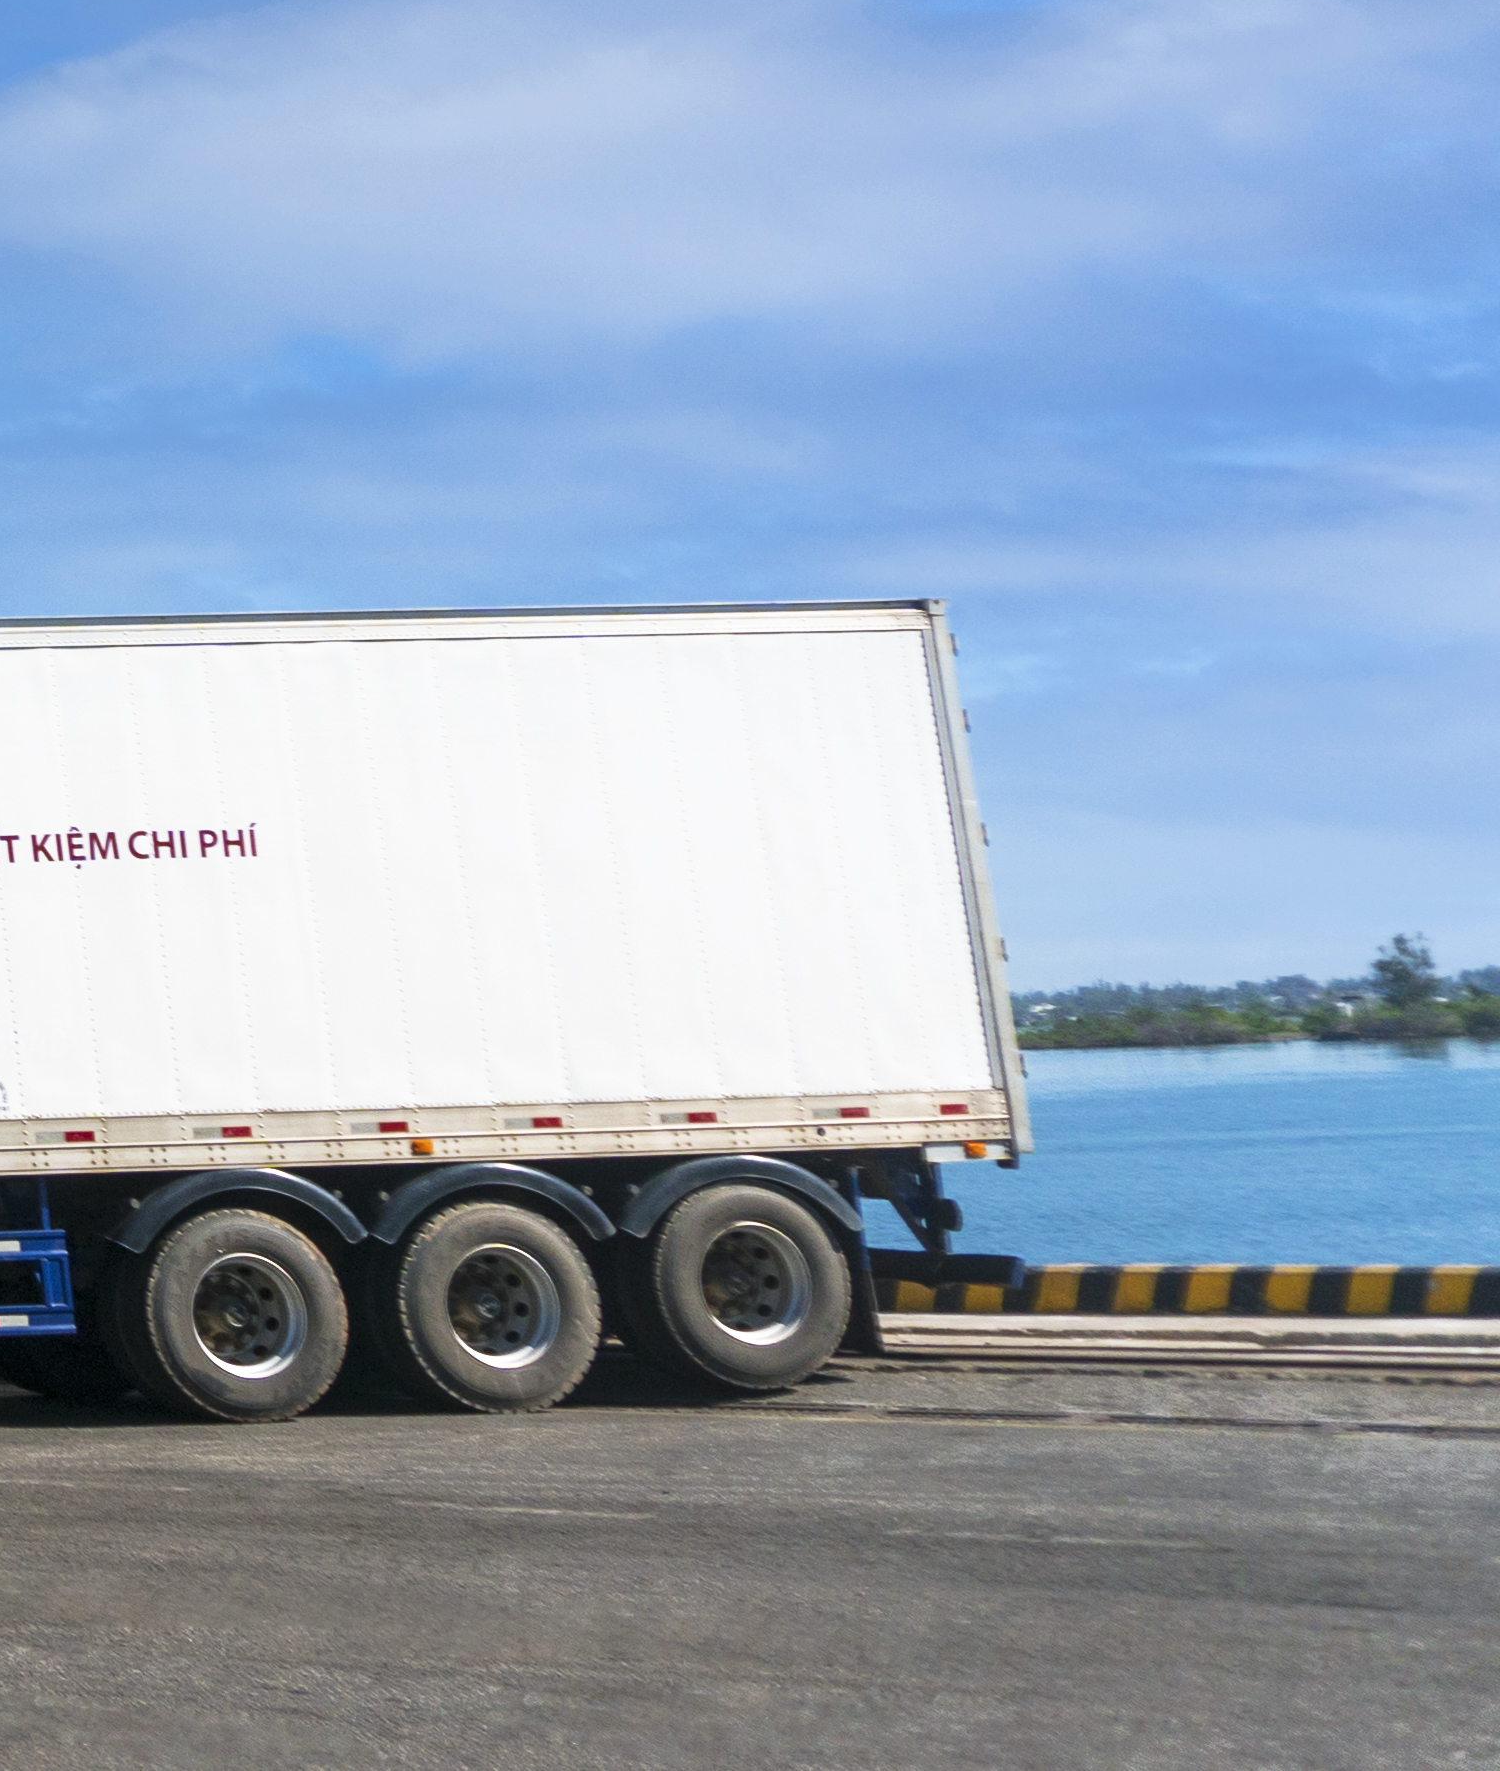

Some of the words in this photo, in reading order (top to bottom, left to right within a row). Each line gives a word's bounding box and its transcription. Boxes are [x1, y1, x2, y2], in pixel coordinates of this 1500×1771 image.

[30, 826, 120, 870] KIỆM
[128, 830, 188, 860] CHI
[198, 822, 257, 858] PHÍ
